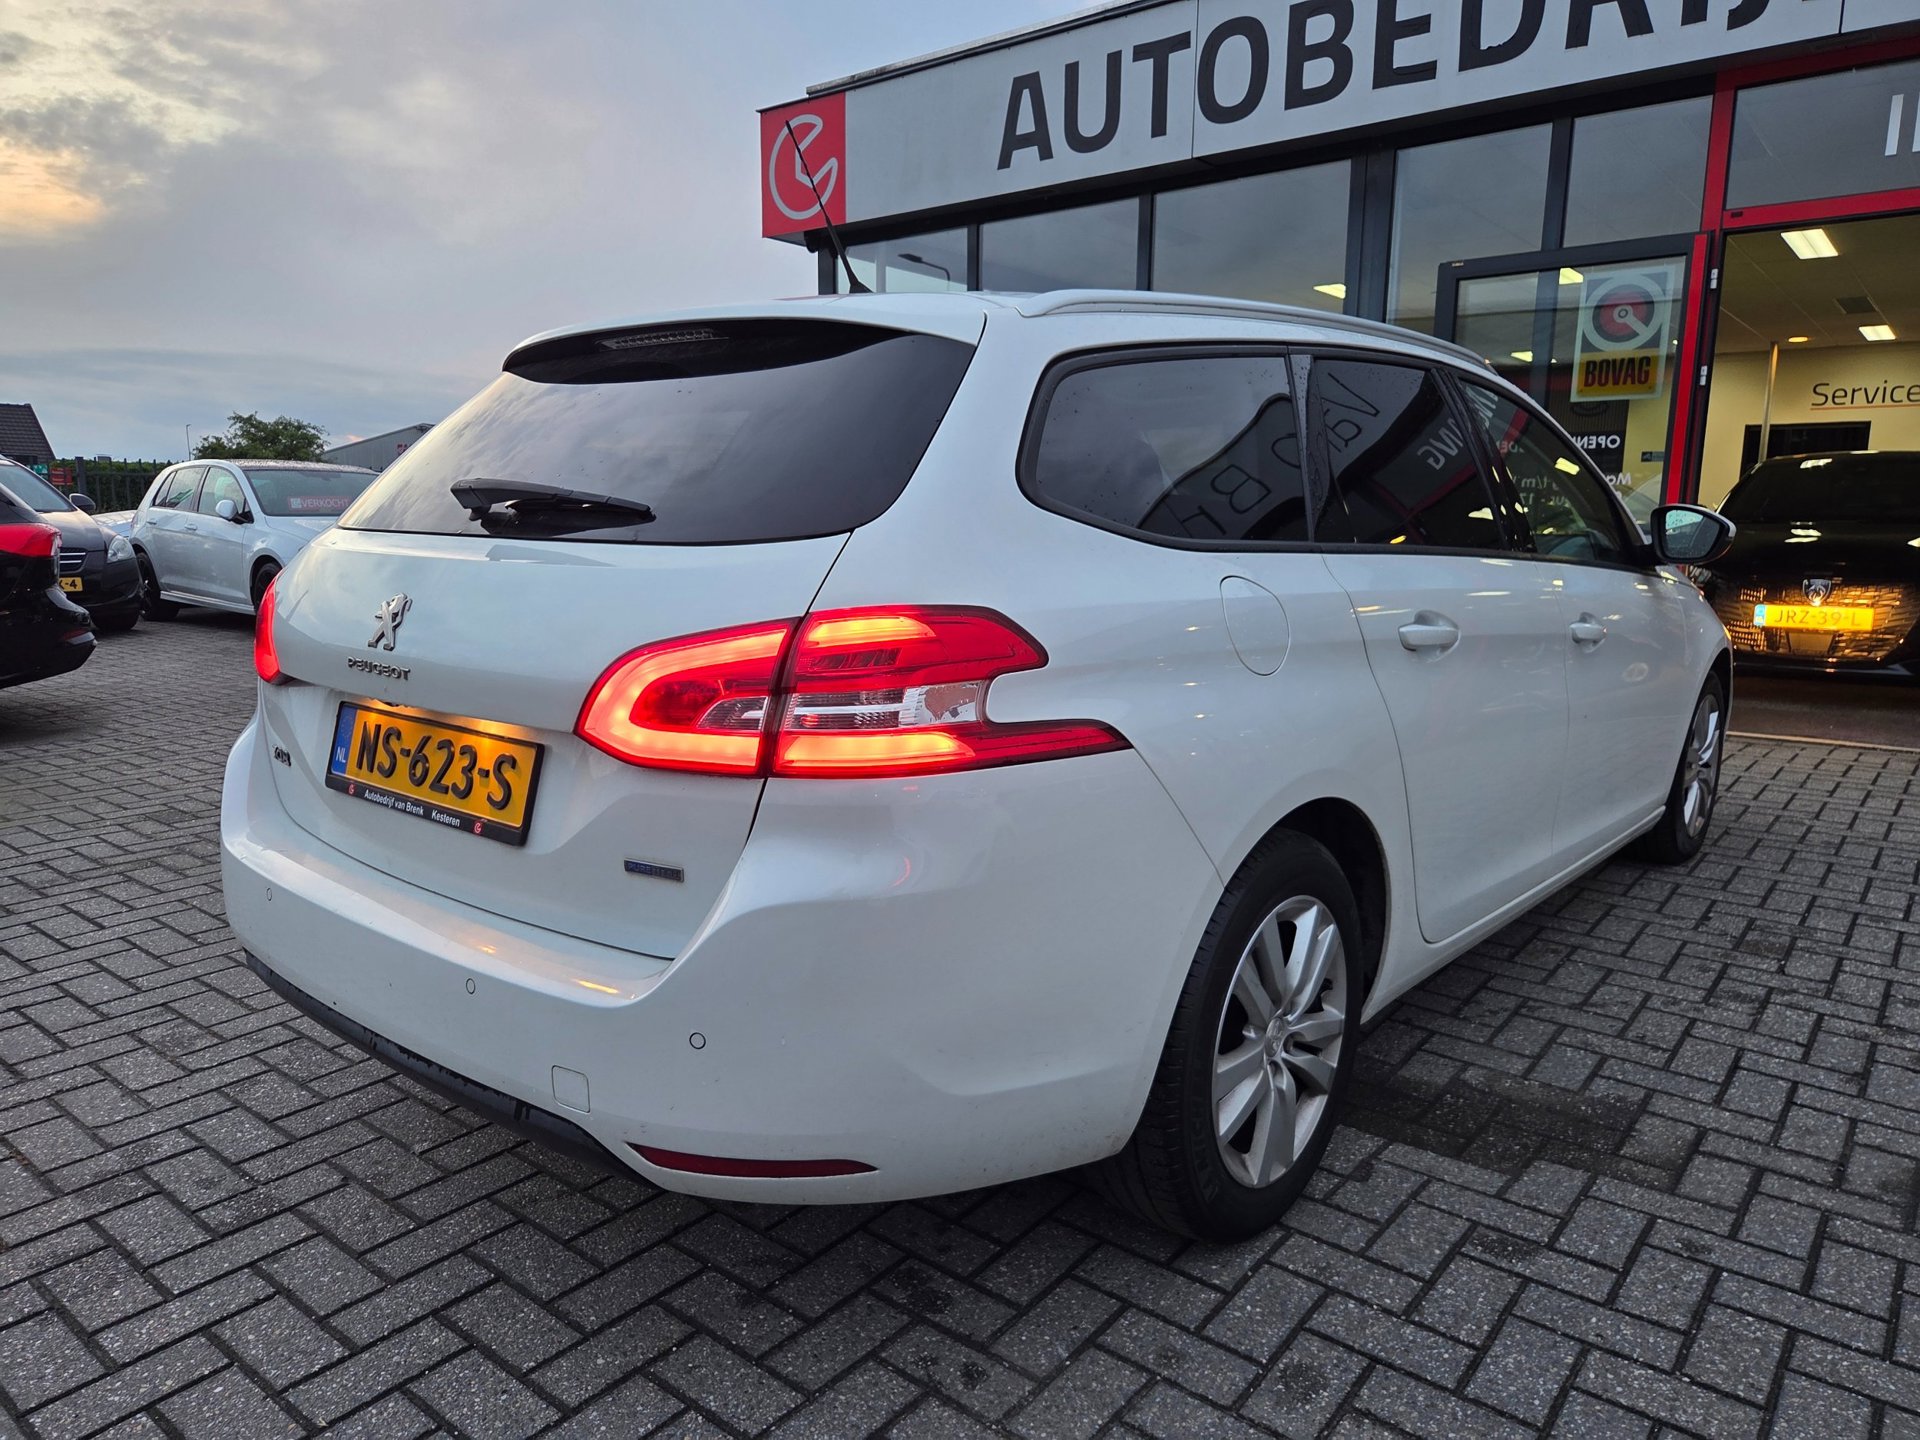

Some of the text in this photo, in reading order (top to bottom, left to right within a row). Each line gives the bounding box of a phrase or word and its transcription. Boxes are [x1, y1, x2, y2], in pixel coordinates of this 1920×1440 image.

[1584, 356, 1651, 387] BOVAG
[1811, 380, 1920, 406] Service
[1774, 610, 1861, 626] JRZ-39-L
[348, 656, 411, 681] PEUGEOT
[335, 747, 346, 764] NL
[356, 721, 517, 810] NS-623-S
[364, 790, 461, 827] Autobedrijf van Brenk Kesteren
